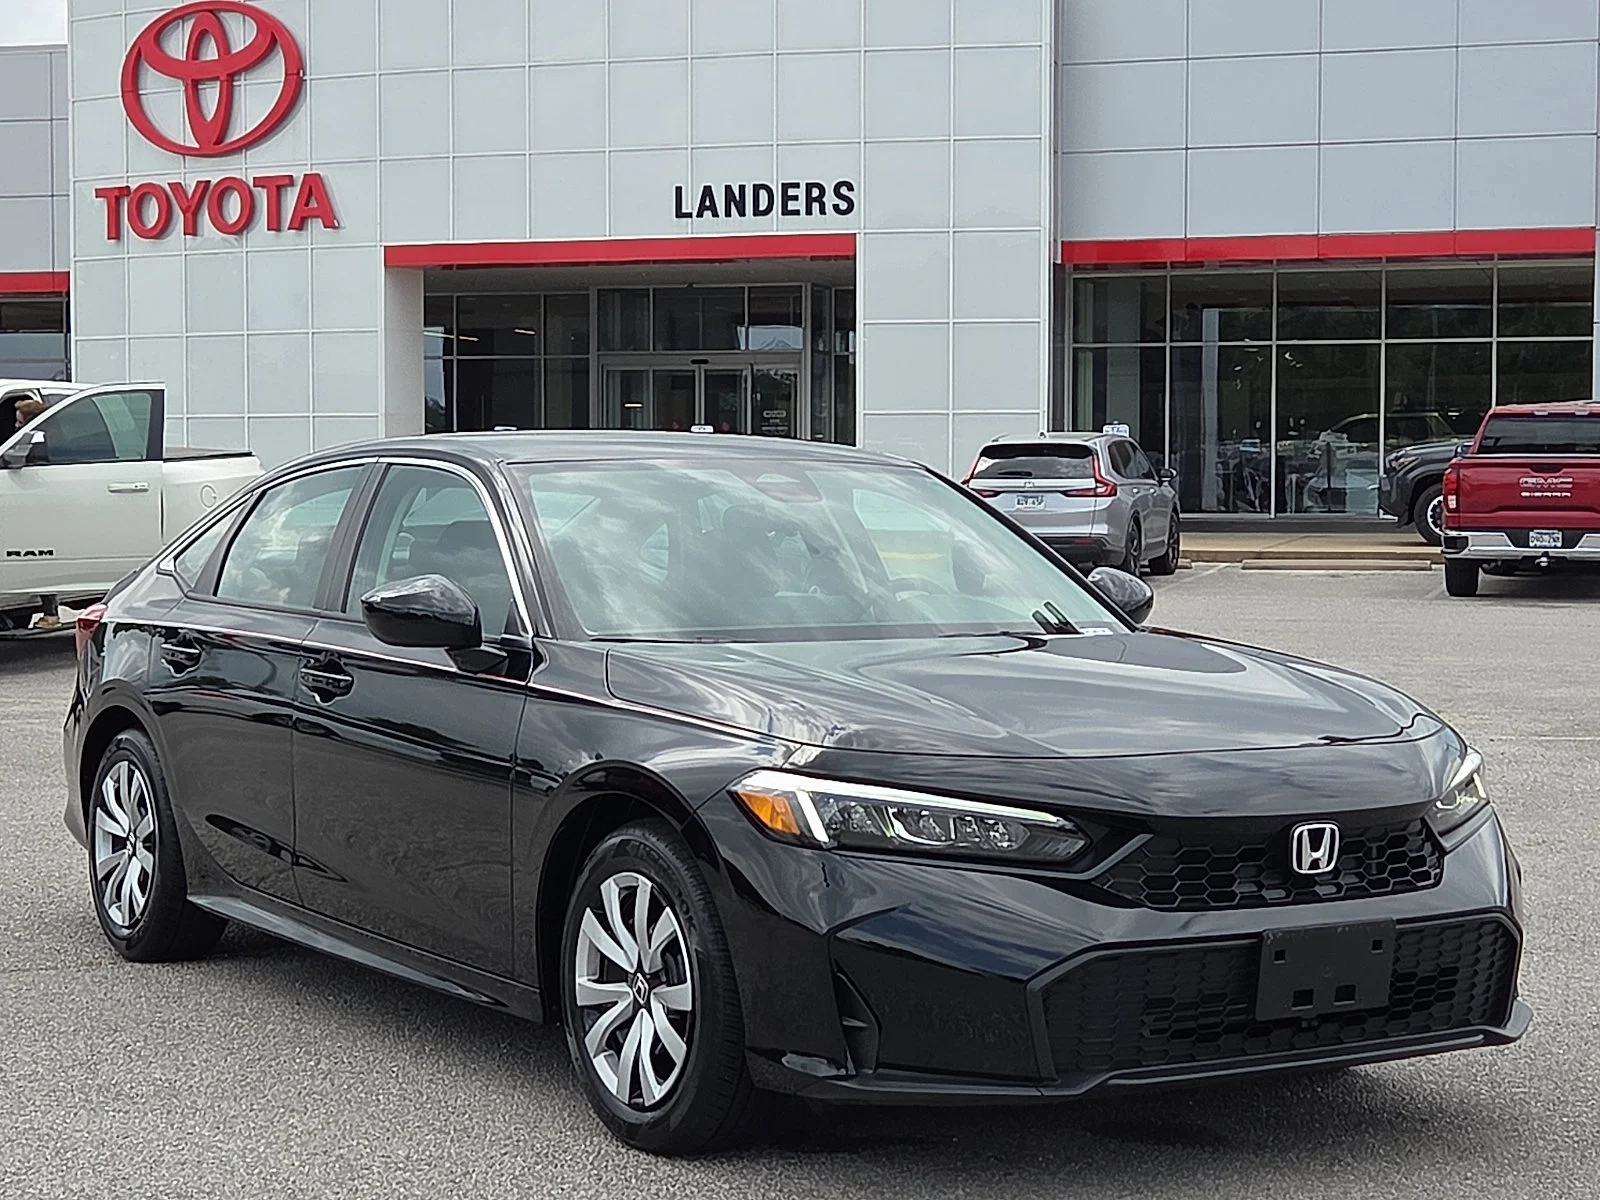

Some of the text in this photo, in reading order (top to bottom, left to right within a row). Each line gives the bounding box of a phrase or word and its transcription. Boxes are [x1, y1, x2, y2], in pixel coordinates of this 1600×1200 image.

[95, 172, 338, 240] TOYOTA
[674, 180, 855, 219] LANDERS
[6, 549, 54, 557] RAM
